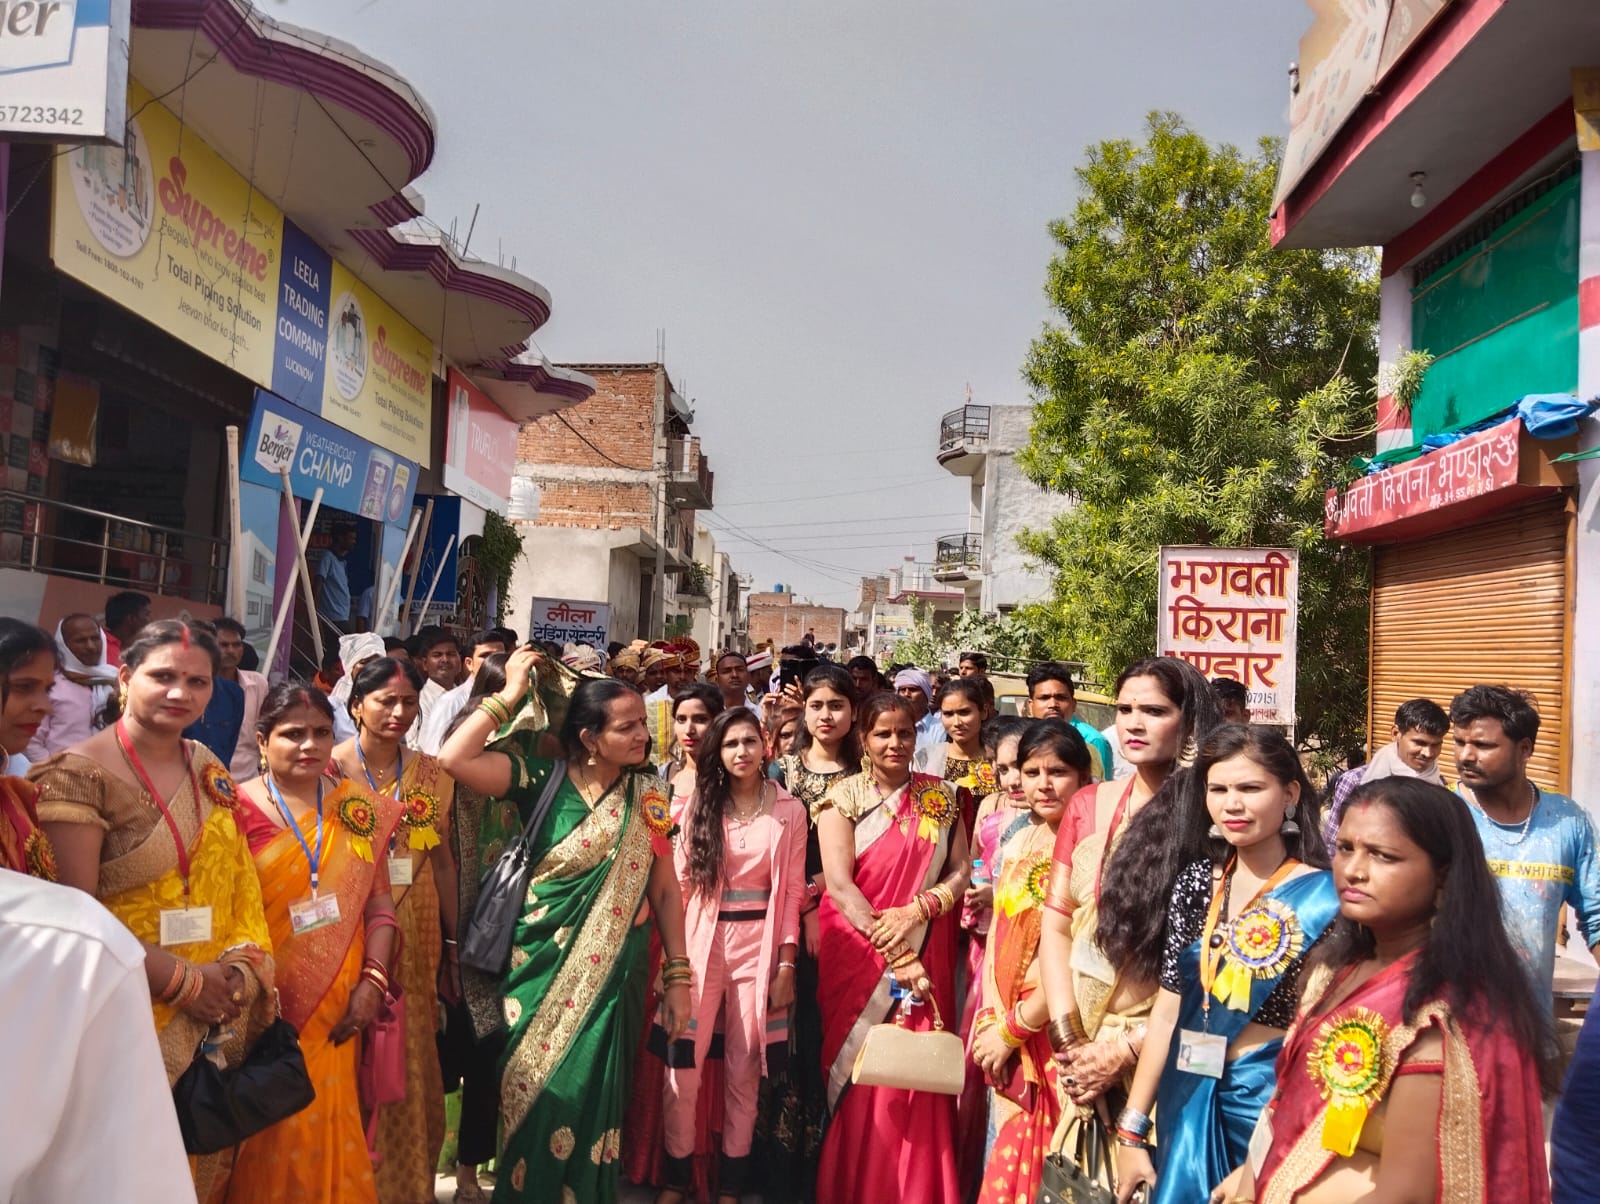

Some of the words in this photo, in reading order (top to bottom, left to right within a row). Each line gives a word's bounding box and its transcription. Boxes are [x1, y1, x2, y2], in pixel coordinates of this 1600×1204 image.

[0, 0, 60, 36] er
[159, 156, 267, 282] Supreme
[161, 217, 189, 248] People
[200, 249, 213, 266] who
[254, 283, 266, 304] best
[294, 256, 319, 292] LEELA
[167, 254, 192, 287] Total
[194, 275, 224, 312] Piping
[226, 296, 261, 332] Solution
[178, 296, 203, 321] Jeevan
[284, 283, 324, 329] TRADING
[278, 316, 325, 361] COMPANY
[372, 324, 426, 395] Supreme
[285, 356, 314, 383] LUCKNOW
[259, 433, 294, 464] Berger
[300, 446, 352, 488] CHAMP
[305, 431, 357, 463] WEATHERCOAT
[1379, 462, 1435, 511] किराना
[1439, 436, 1497, 488] भण्डार
[1168, 552, 1290, 597] भगवती
[547, 602, 596, 624] लीला
[1168, 595, 1287, 643] किराना
[1165, 650, 1282, 688] ण्डार
